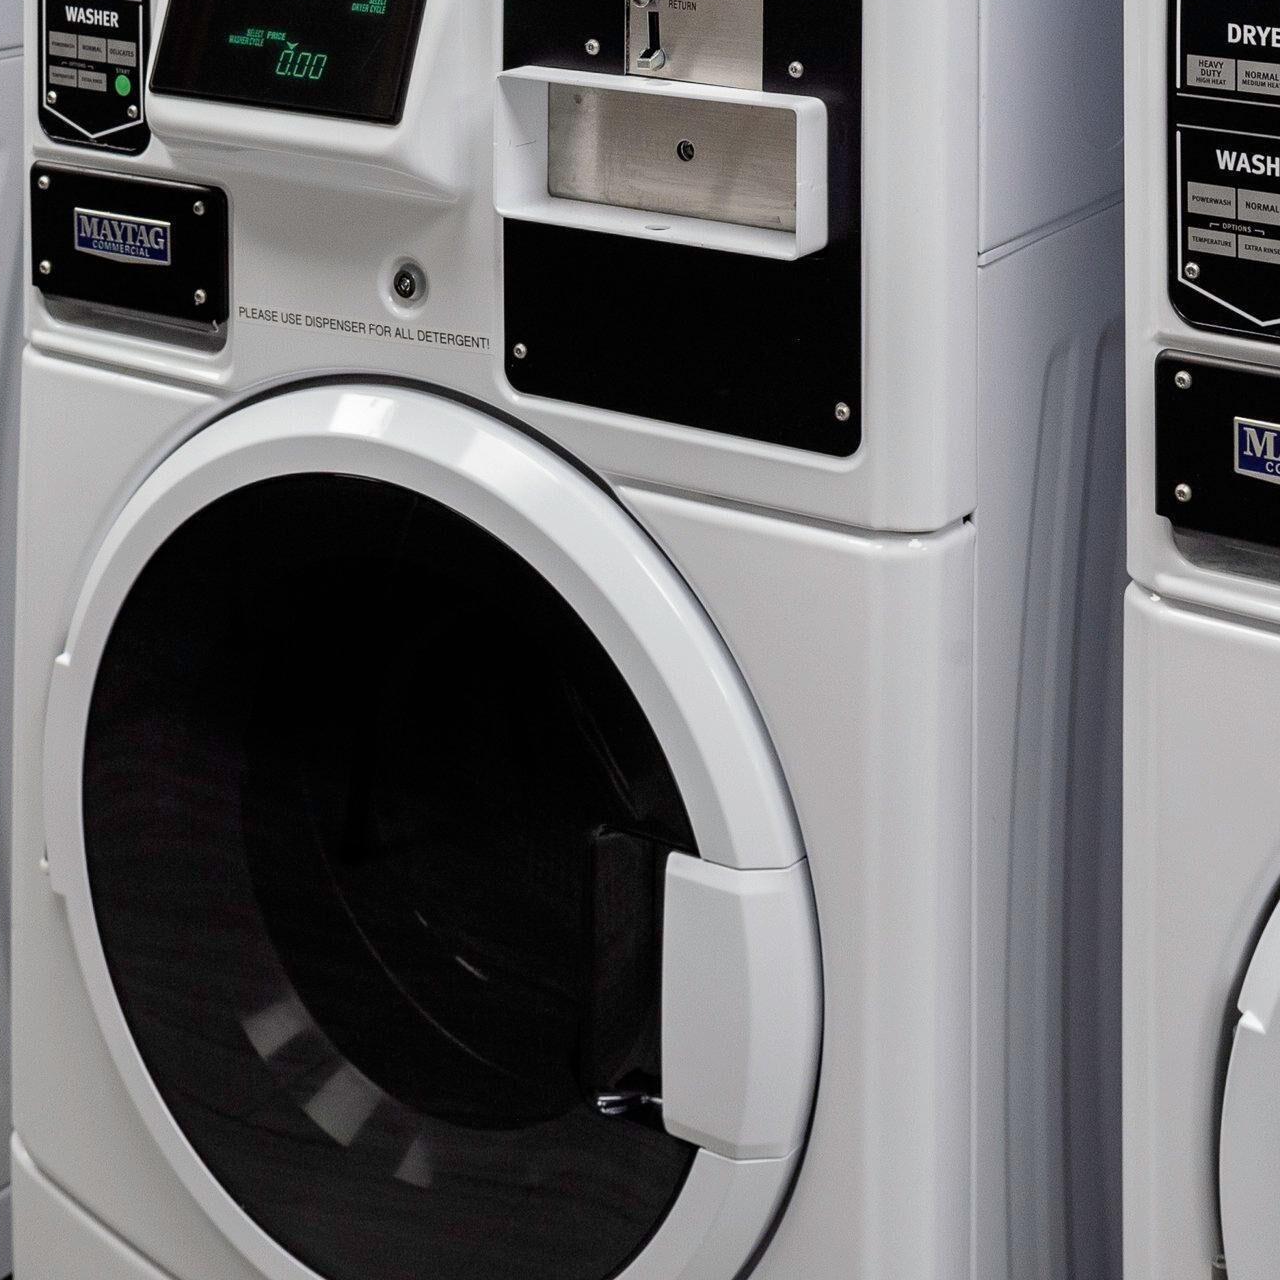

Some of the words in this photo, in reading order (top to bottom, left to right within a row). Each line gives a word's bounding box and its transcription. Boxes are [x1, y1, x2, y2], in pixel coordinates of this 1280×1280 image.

[669, 0, 697, 11] RETURN
[65, 5, 119, 28] WASHER
[276, 50, 328, 80] 0.00
[1198, 59, 1224, 69] HEAVY
[1200, 68, 1222, 78] DUTY
[1245, 71, 1280, 82] NORMAL
[1196, 76, 1211, 84] HIGH
[1211, 77, 1227, 86] HEAT
[1242, 79, 1267, 88] MEDIUM
[1191, 194, 1232, 207] POWERWASH
[1245, 201, 1280, 214] NORMAL
[79, 215, 165, 250] MAYTAG
[1222, 222, 1252, 233] OPTIONS
[1191, 235, 1232, 248] TEMPERATURE
[92, 240, 150, 258] COMMERCIAL
[1244, 243, 1263, 253] EXTRA
[1263, 245, 1280, 256] RINSE
[238, 306, 278, 323] PLEASE
[281, 312, 302, 326] USE
[305, 315, 366, 335] DISPENSER
[369, 323, 392, 338] FOR
[394, 327, 415, 341] ALL
[417, 330, 490, 350] DETERGENT!
